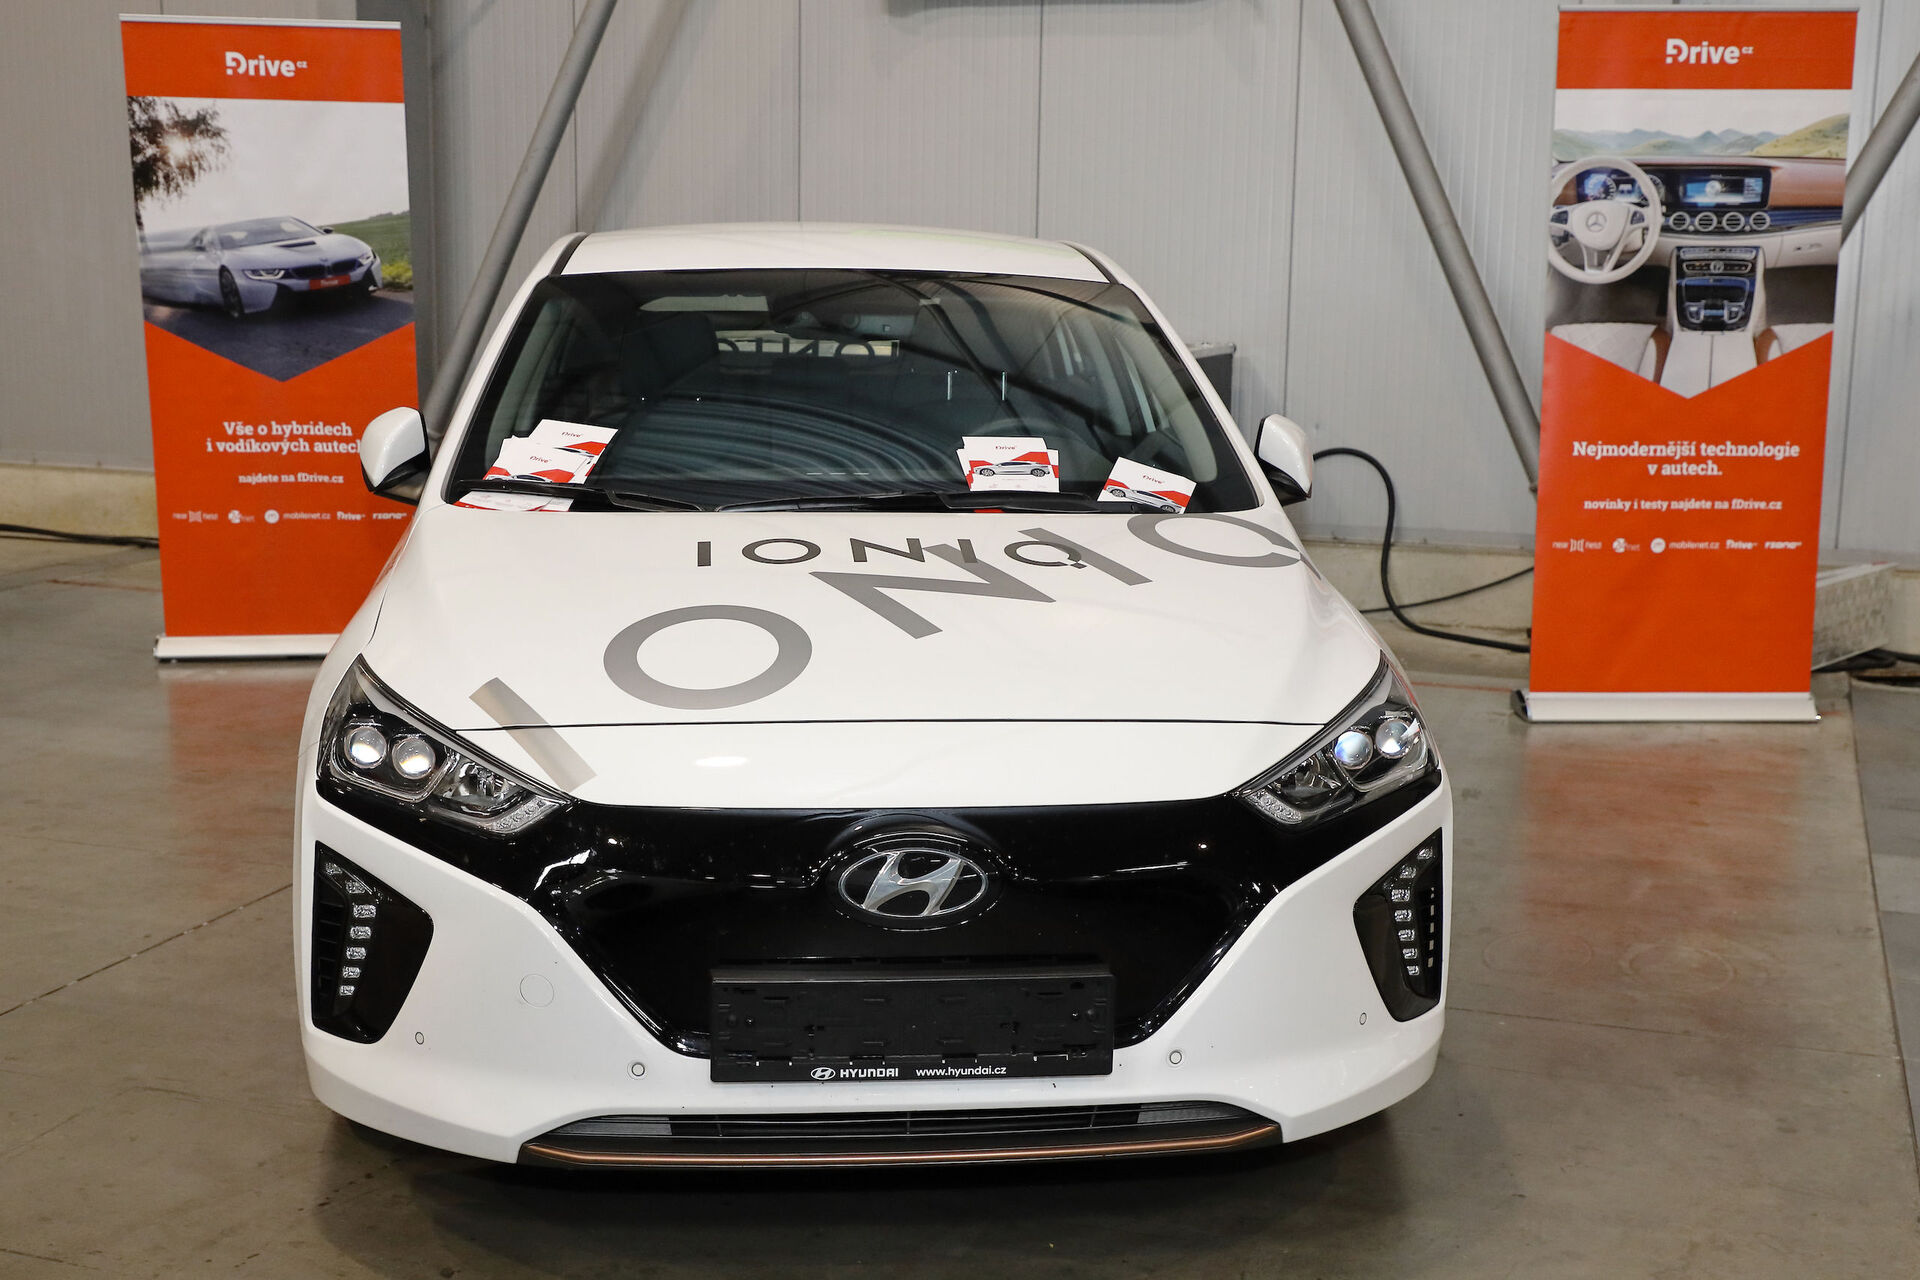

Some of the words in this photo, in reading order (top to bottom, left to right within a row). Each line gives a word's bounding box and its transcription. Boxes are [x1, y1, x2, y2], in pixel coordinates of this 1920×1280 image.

[223, 421, 254, 436] Vše
[257, 424, 268, 436] o
[271, 420, 353, 438] hybridech
[206, 438, 213, 452] i
[216, 438, 311, 455] vodíkových
[1572, 440, 1697, 460] Nejmodernější
[1700, 441, 1800, 460] technologie
[1647, 463, 1658, 476] v
[1661, 461, 1723, 476] autech.
[238, 473, 278, 485] najdete
[281, 474, 296, 483] na
[1583, 499, 1631, 511] novinky
[1633, 498, 1639, 510] i
[1640, 500, 1669, 511] testy
[1670, 499, 1712, 511] najdete
[1714, 501, 1729, 510] na
[697, 537, 1087, 569] IONIQ
[840, 1067, 899, 1078] HYUNDAI
[915, 1065, 1007, 1077] www.hyundai.cz
